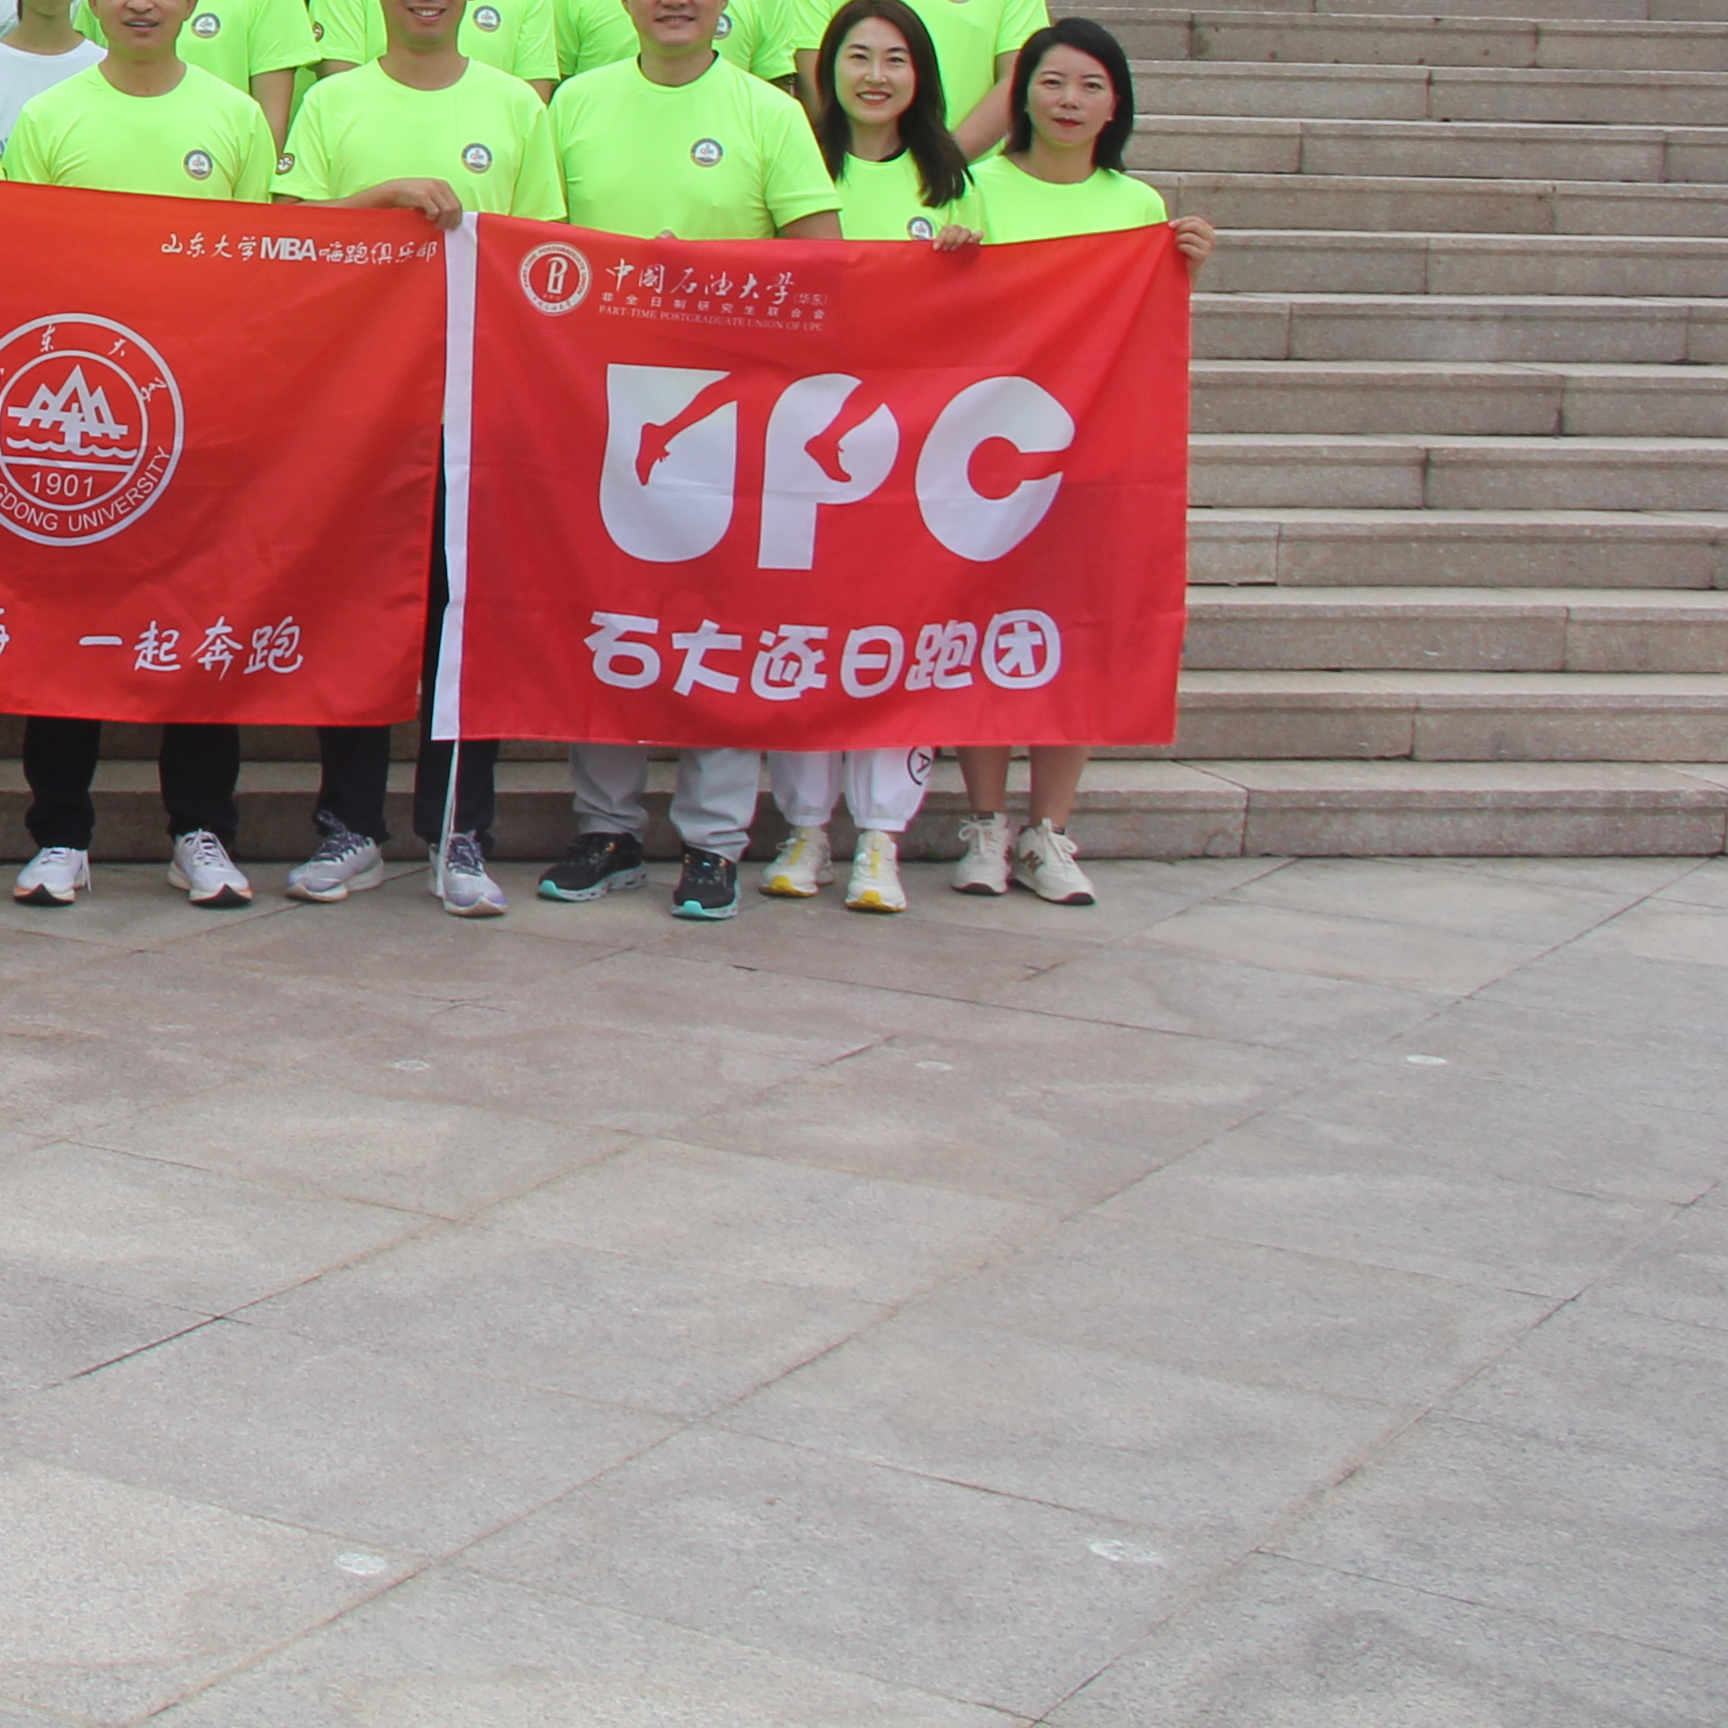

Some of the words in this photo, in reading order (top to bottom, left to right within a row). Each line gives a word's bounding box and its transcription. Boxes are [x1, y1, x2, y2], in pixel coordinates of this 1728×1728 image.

[599, 305, 657, 319] PART-TIME
[660, 311, 745, 327] POSTGRADUATE
[747, 319, 783, 330] UNION
[601, 292, 825, 320] 非全日制研究生联合会
[31, 472, 94, 498] 1901
[68, 446, 171, 532] UNIVERSITY
[598, 363, 1076, 572] UPC
[78, 615, 303, 681] 一起奔跑
[584, 609, 1062, 701] 石大逐日跑团
